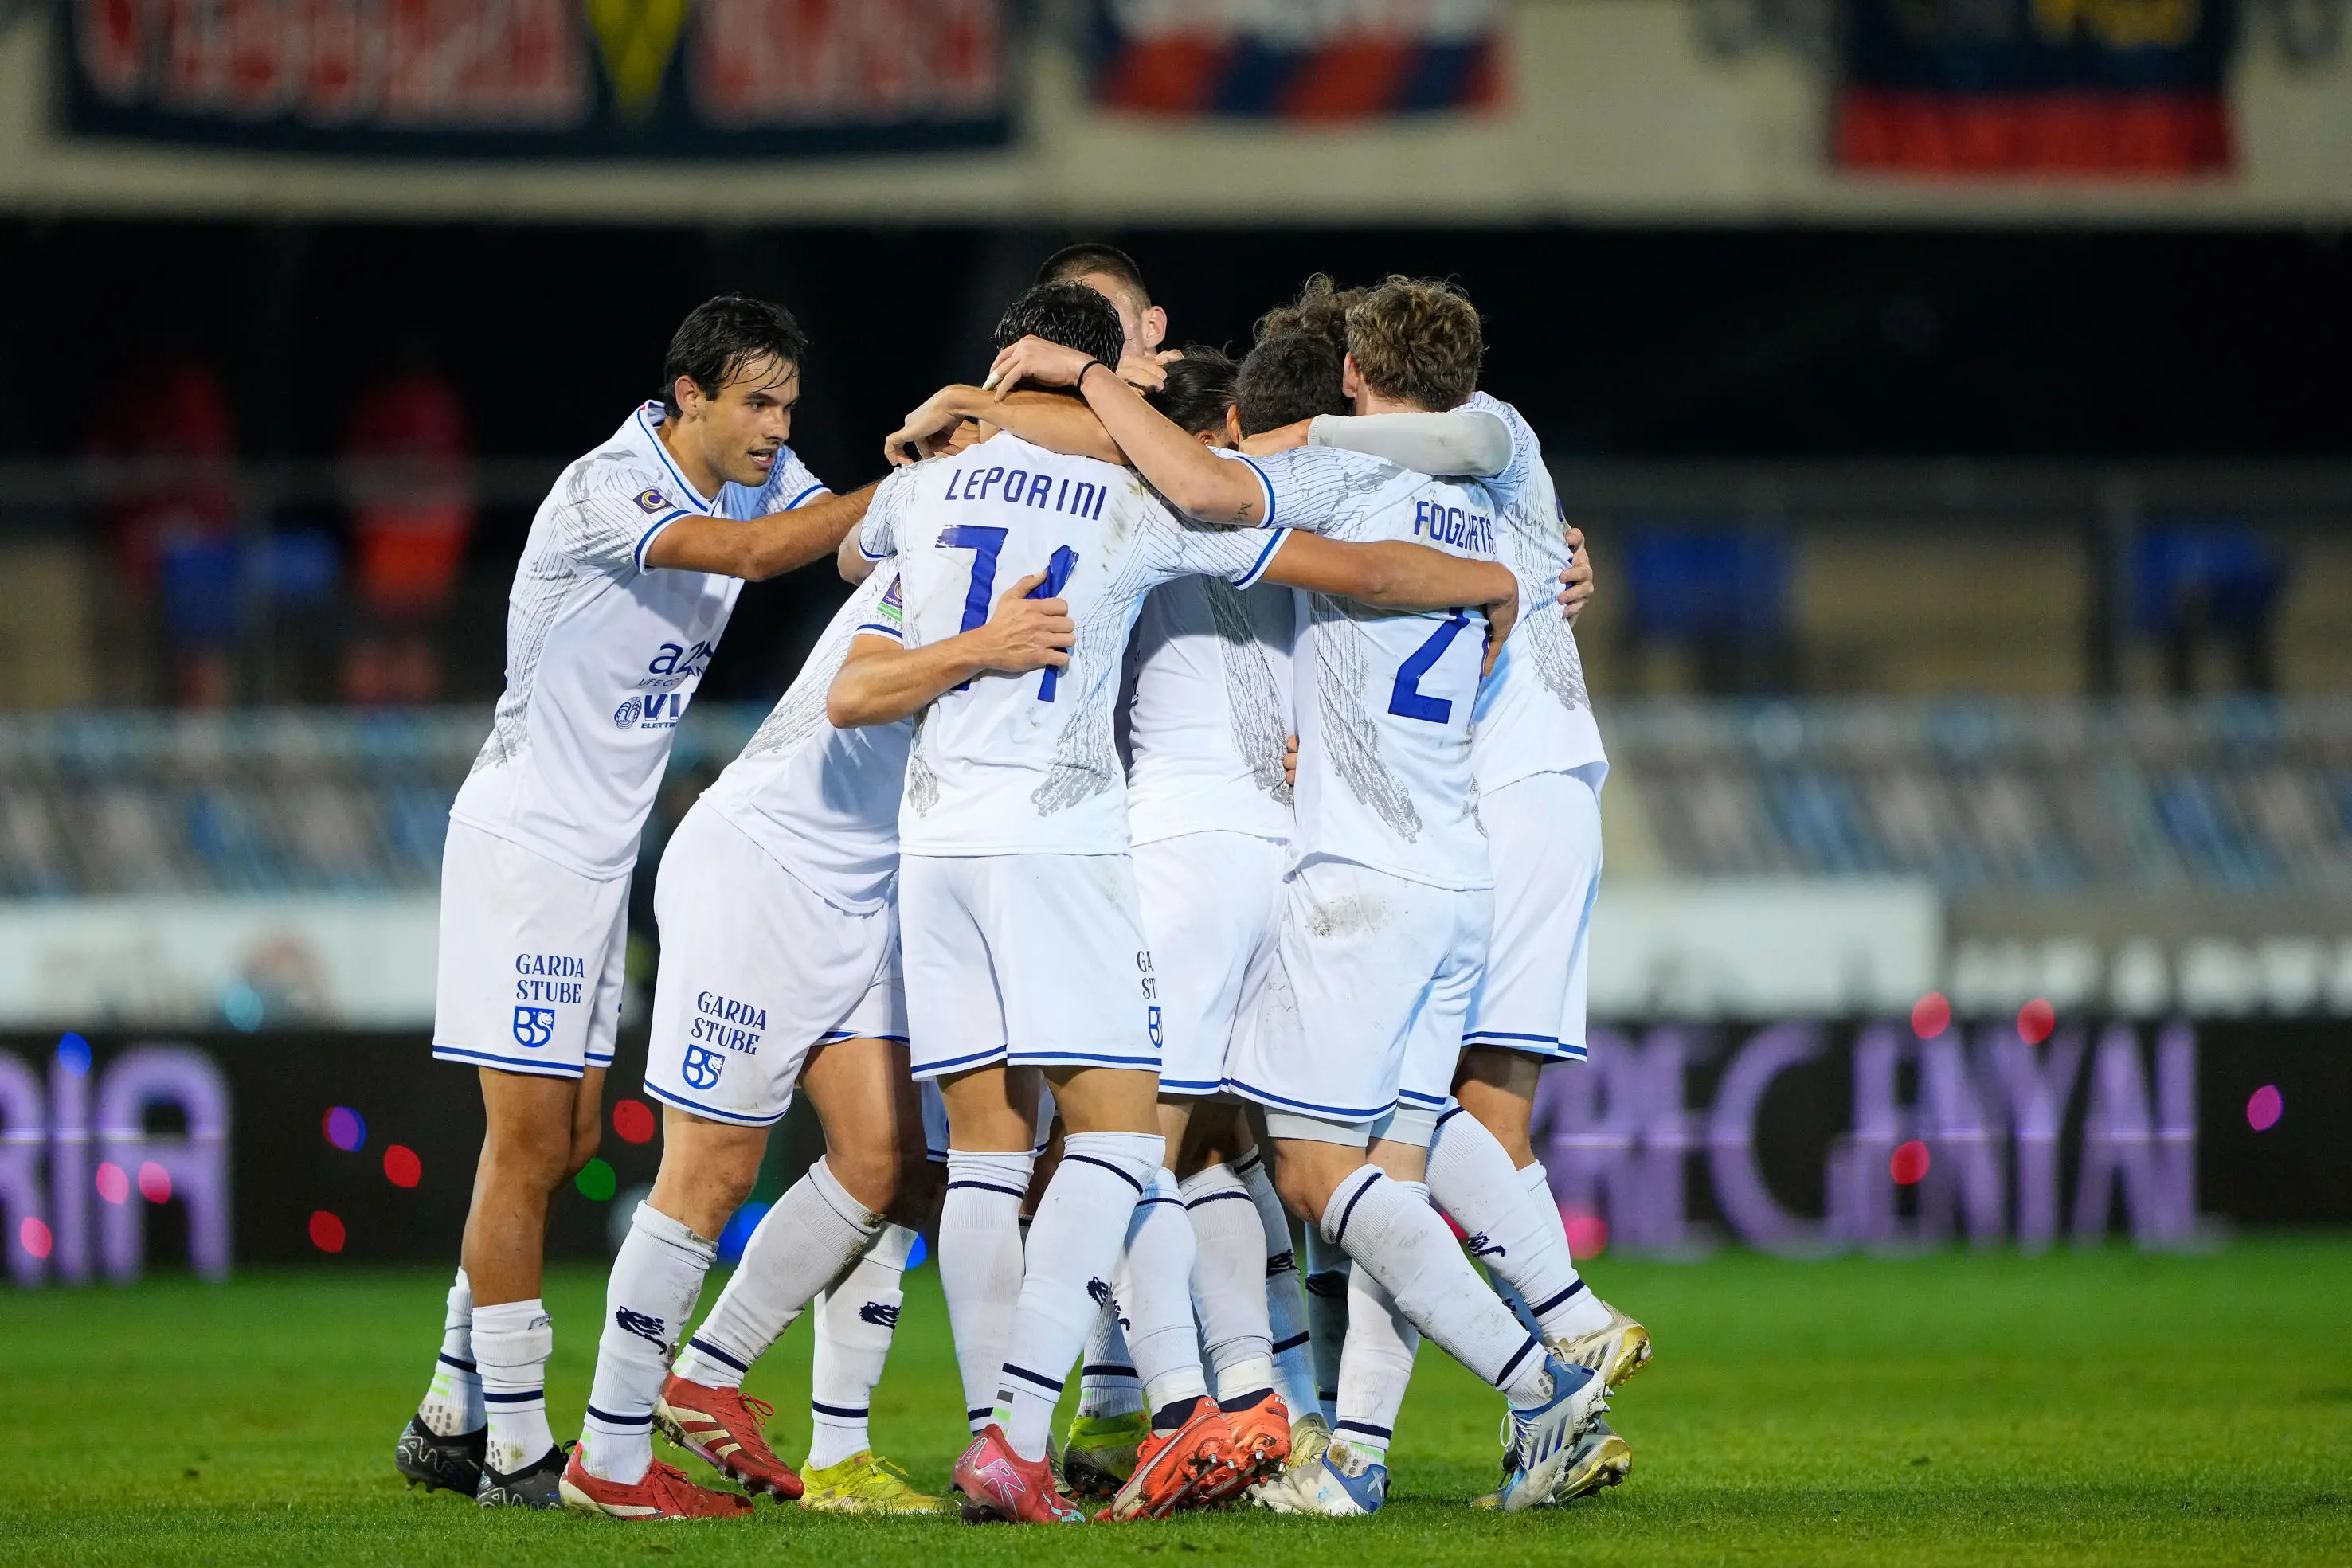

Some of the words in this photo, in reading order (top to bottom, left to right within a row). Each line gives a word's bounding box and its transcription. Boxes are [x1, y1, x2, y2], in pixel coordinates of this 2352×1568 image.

[945, 467, 1107, 521] LEPORINI
[1387, 607, 1488, 725] 2
[644, 693, 695, 721] VI
[515, 953, 585, 978] GARDA
[516, 979, 582, 1004] STUBE
[697, 991, 767, 1031] GARDA
[691, 1017, 761, 1055] STUBE
